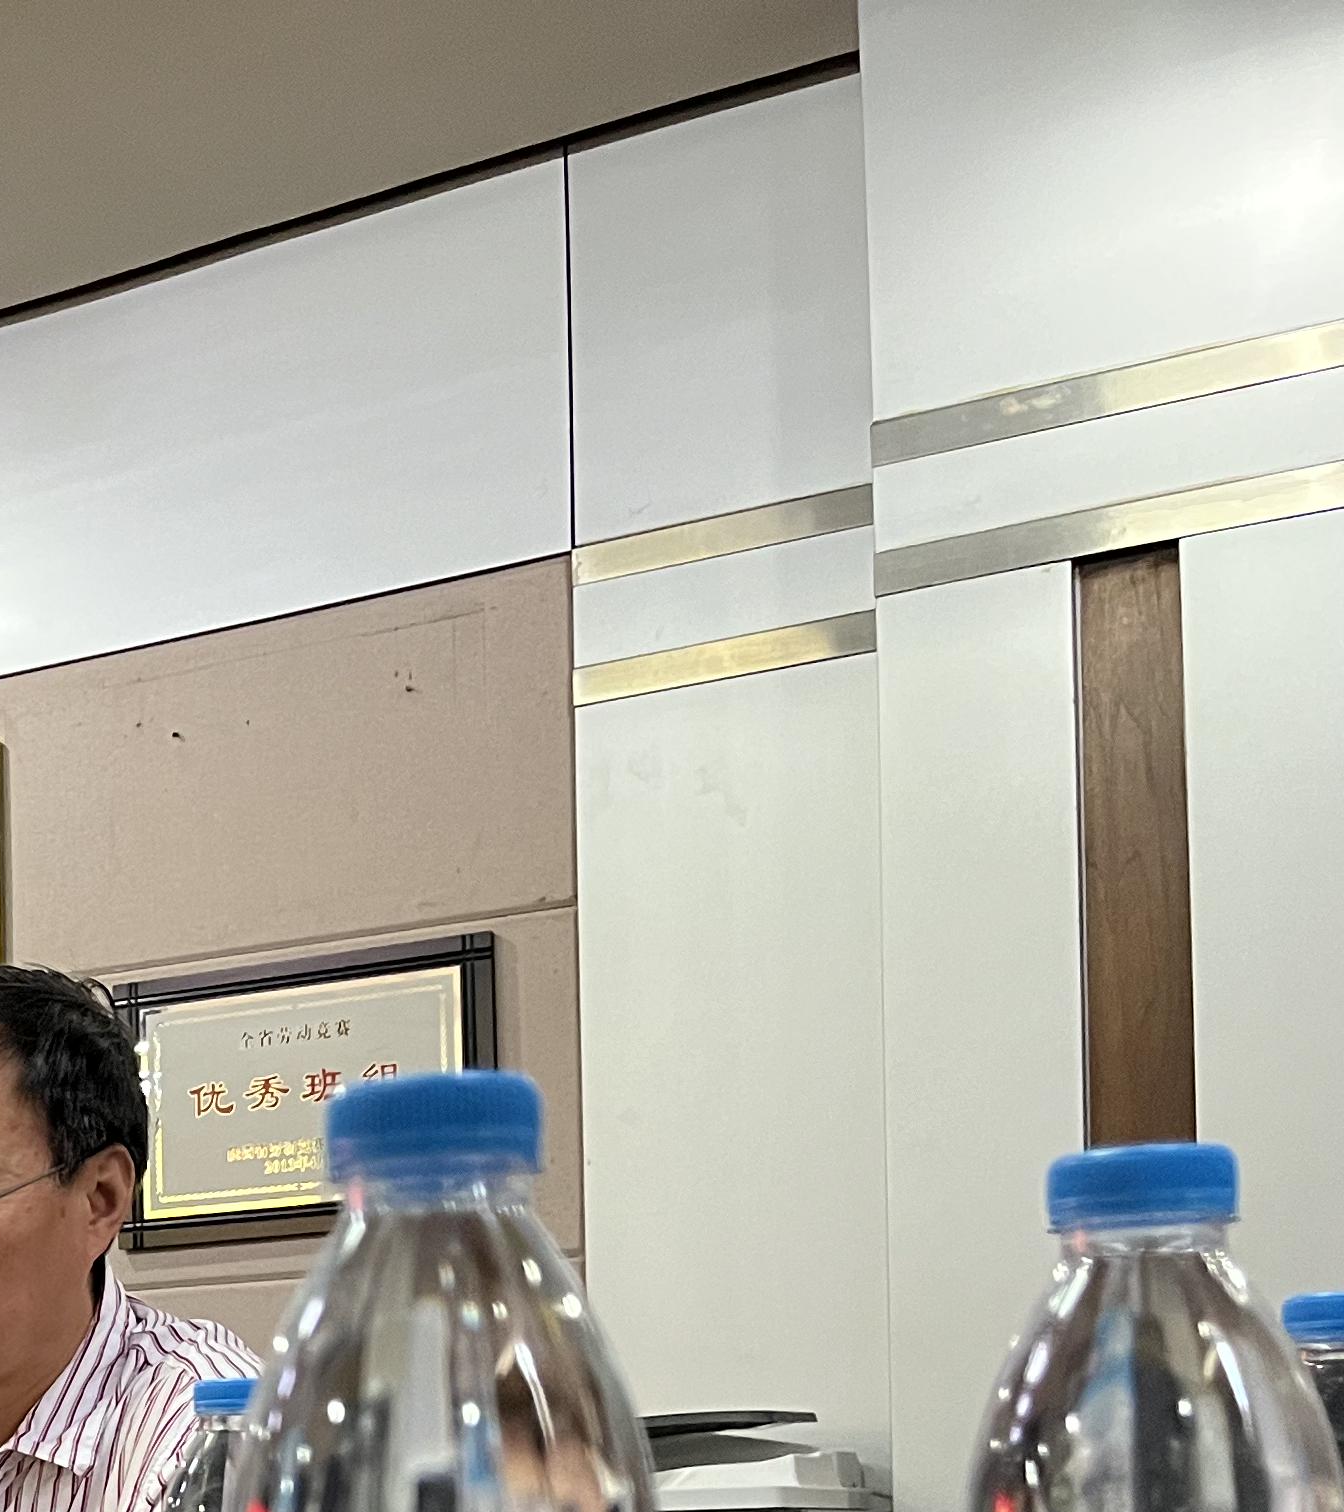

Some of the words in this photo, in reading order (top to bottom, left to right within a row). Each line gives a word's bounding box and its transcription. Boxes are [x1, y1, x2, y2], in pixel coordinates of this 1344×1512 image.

[240, 1018, 352, 1049] 全省劳动竞赛
